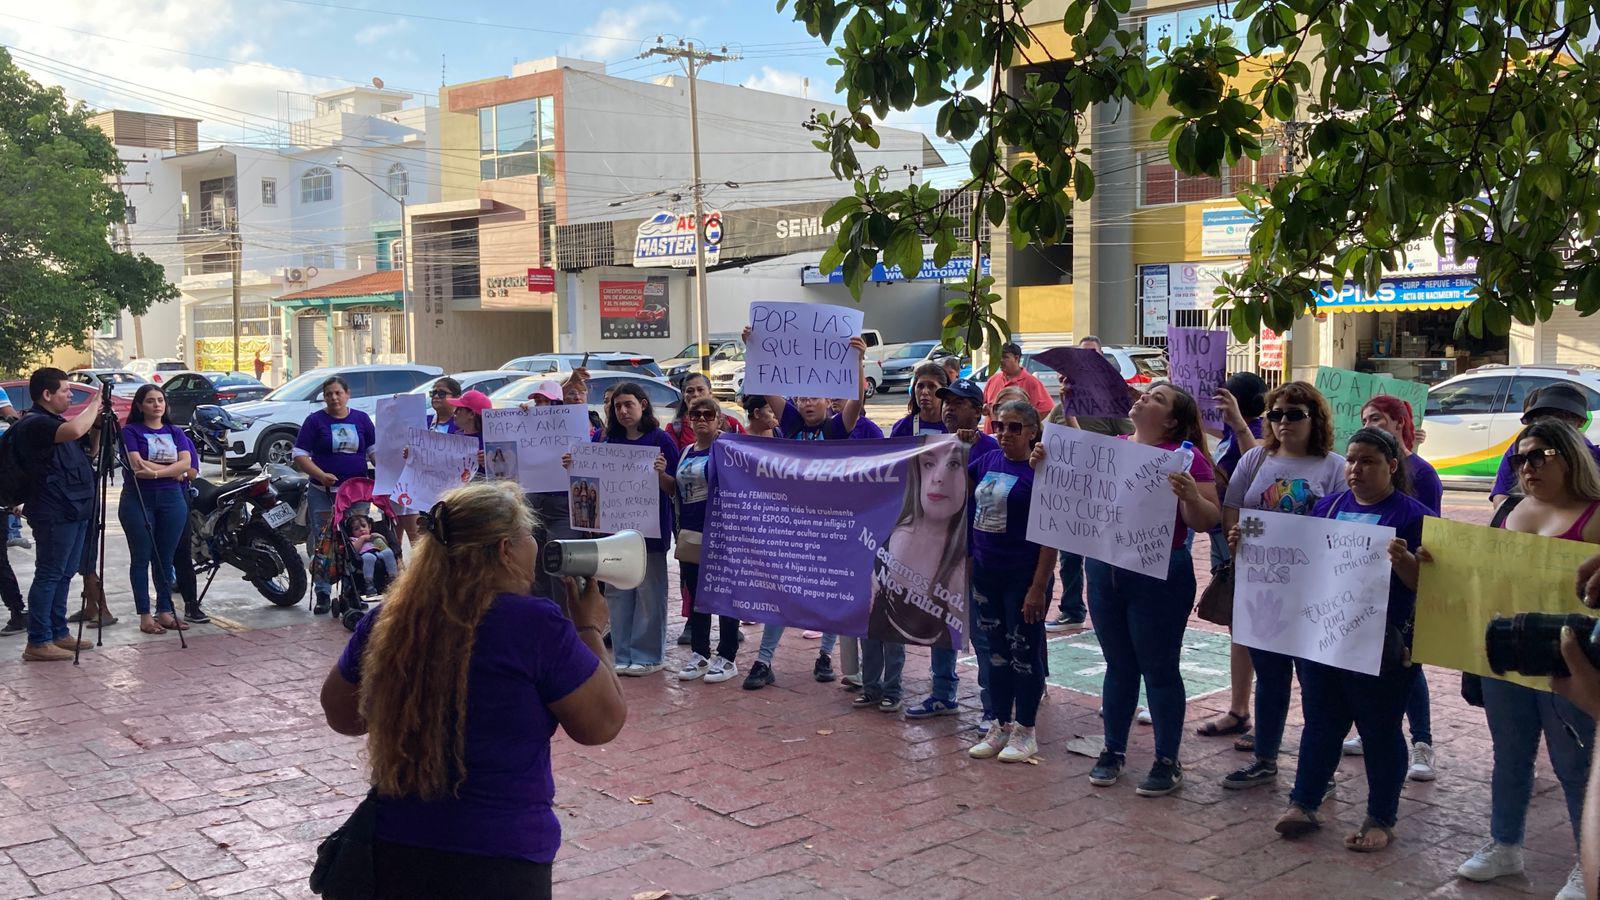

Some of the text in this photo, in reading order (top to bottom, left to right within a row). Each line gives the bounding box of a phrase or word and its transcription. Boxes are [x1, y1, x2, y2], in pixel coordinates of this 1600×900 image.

[638, 235, 695, 257] MASTER
[751, 305, 853, 339] POR LAS
[762, 336, 852, 365] QUE HOY
[1185, 333, 1211, 355] NO
[1319, 371, 1342, 391] NO
[1349, 376, 1361, 398] A
[488, 419, 568, 436] PARA ANA
[1048, 433, 1117, 477] QUE SER
[757, 454, 802, 479] ANA
[802, 456, 899, 483] BEATRIZ
[601, 479, 650, 493] VICTOR
[1044, 464, 1117, 502] MUJER NO
[741, 501, 751, 510] 26
[752, 502, 762, 511] de
[762, 502, 780, 512] junio
[780, 504, 790, 512] mi
[1040, 493, 1125, 524] NOS CUESTE
[739, 514, 750, 523] por
[752, 514, 761, 522] mi
[762, 514, 792, 525] ESPOSO,
[793, 516, 811, 527] quien
[812, 519, 823, 527] me
[758, 524, 767, 534] de
[1039, 513, 1101, 539] LA VIDA
[767, 536, 789, 547] contra
[790, 540, 804, 548] una
[778, 550, 816, 561] lentamente
[858, 526, 877, 551] No
[876, 546, 930, 591] estamos
[778, 583, 802, 594] VICTOR
[877, 565, 904, 596] Nos
